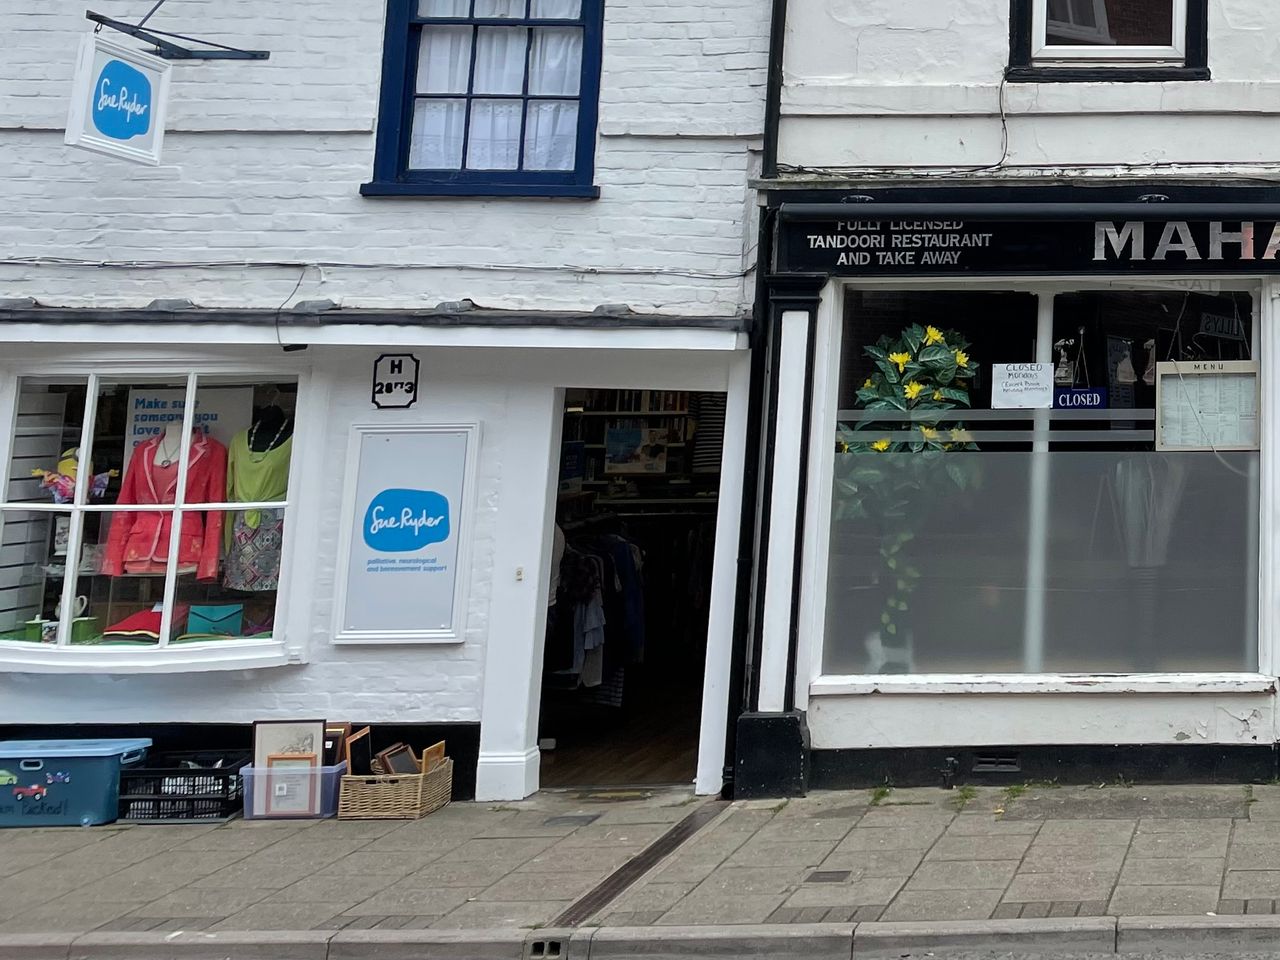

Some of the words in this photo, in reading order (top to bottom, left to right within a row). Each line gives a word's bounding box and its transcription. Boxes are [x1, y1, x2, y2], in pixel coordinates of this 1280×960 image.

[98, 78, 118, 110] Sue
[118, 86, 148, 122] Ryder
[837, 221, 881, 230] FULLY
[889, 221, 964, 230] LICENSED
[807, 234, 885, 248] TANDOORI
[891, 234, 993, 248] RESTAURANT
[836, 251, 870, 266] AND
[875, 251, 915, 265] TAKE
[920, 251, 962, 265] AWAY
[390, 359, 403, 374] H
[1005, 363, 1043, 372] CLOSED
[135, 398, 168, 409] Make
[1058, 393, 1101, 406] CLOSED
[134, 413, 184, 423] someon
[195, 413, 218, 424] you
[133, 424, 160, 435] love
[370, 505, 400, 534] Sue
[400, 507, 445, 536] Ryder
